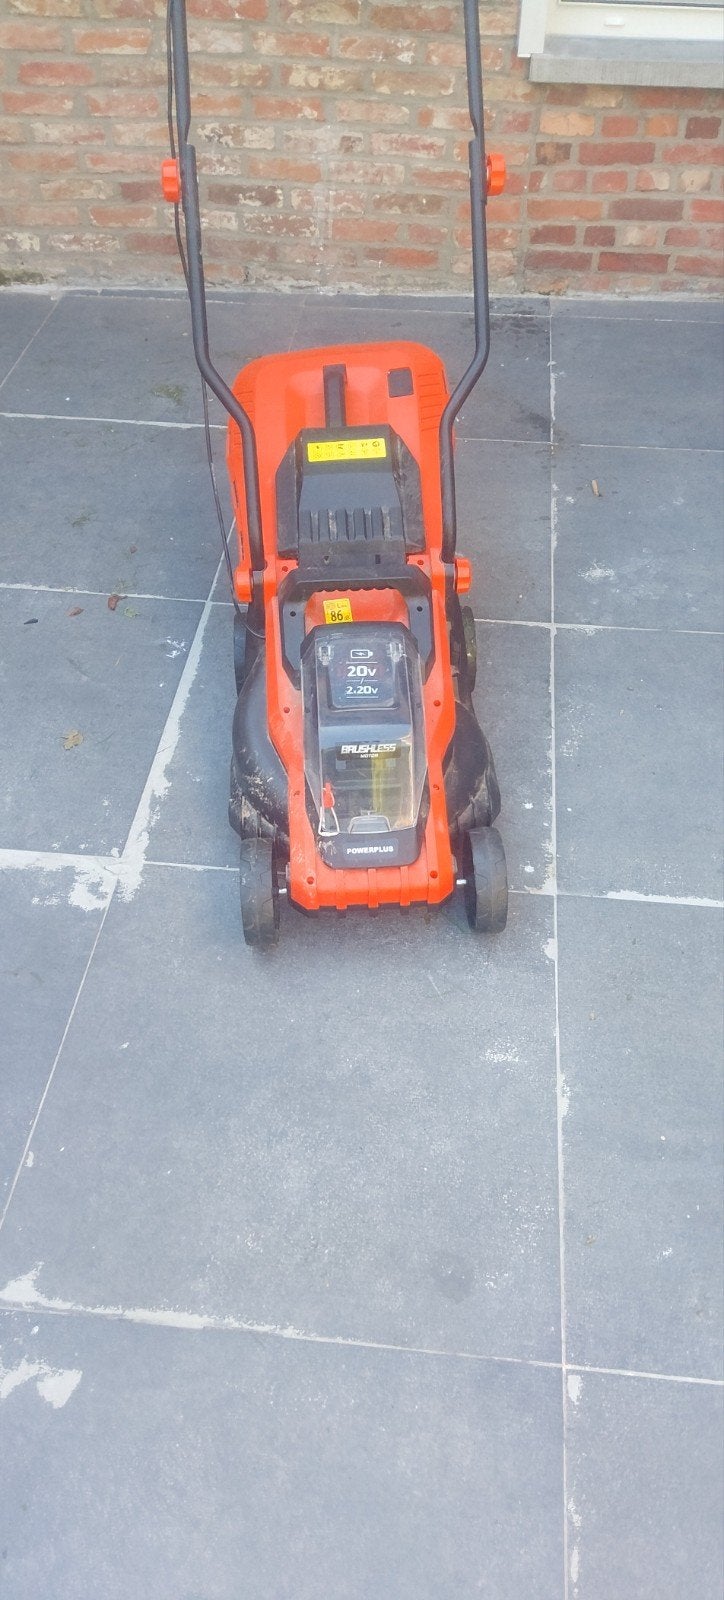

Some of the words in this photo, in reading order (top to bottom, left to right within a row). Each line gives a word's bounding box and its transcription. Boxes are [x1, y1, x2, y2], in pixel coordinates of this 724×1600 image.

[330, 610, 343, 622] 86
[347, 665, 377, 677] 20v
[341, 743, 396, 754] BRUSHLESS
[346, 845, 394, 854] POWERPLUS
